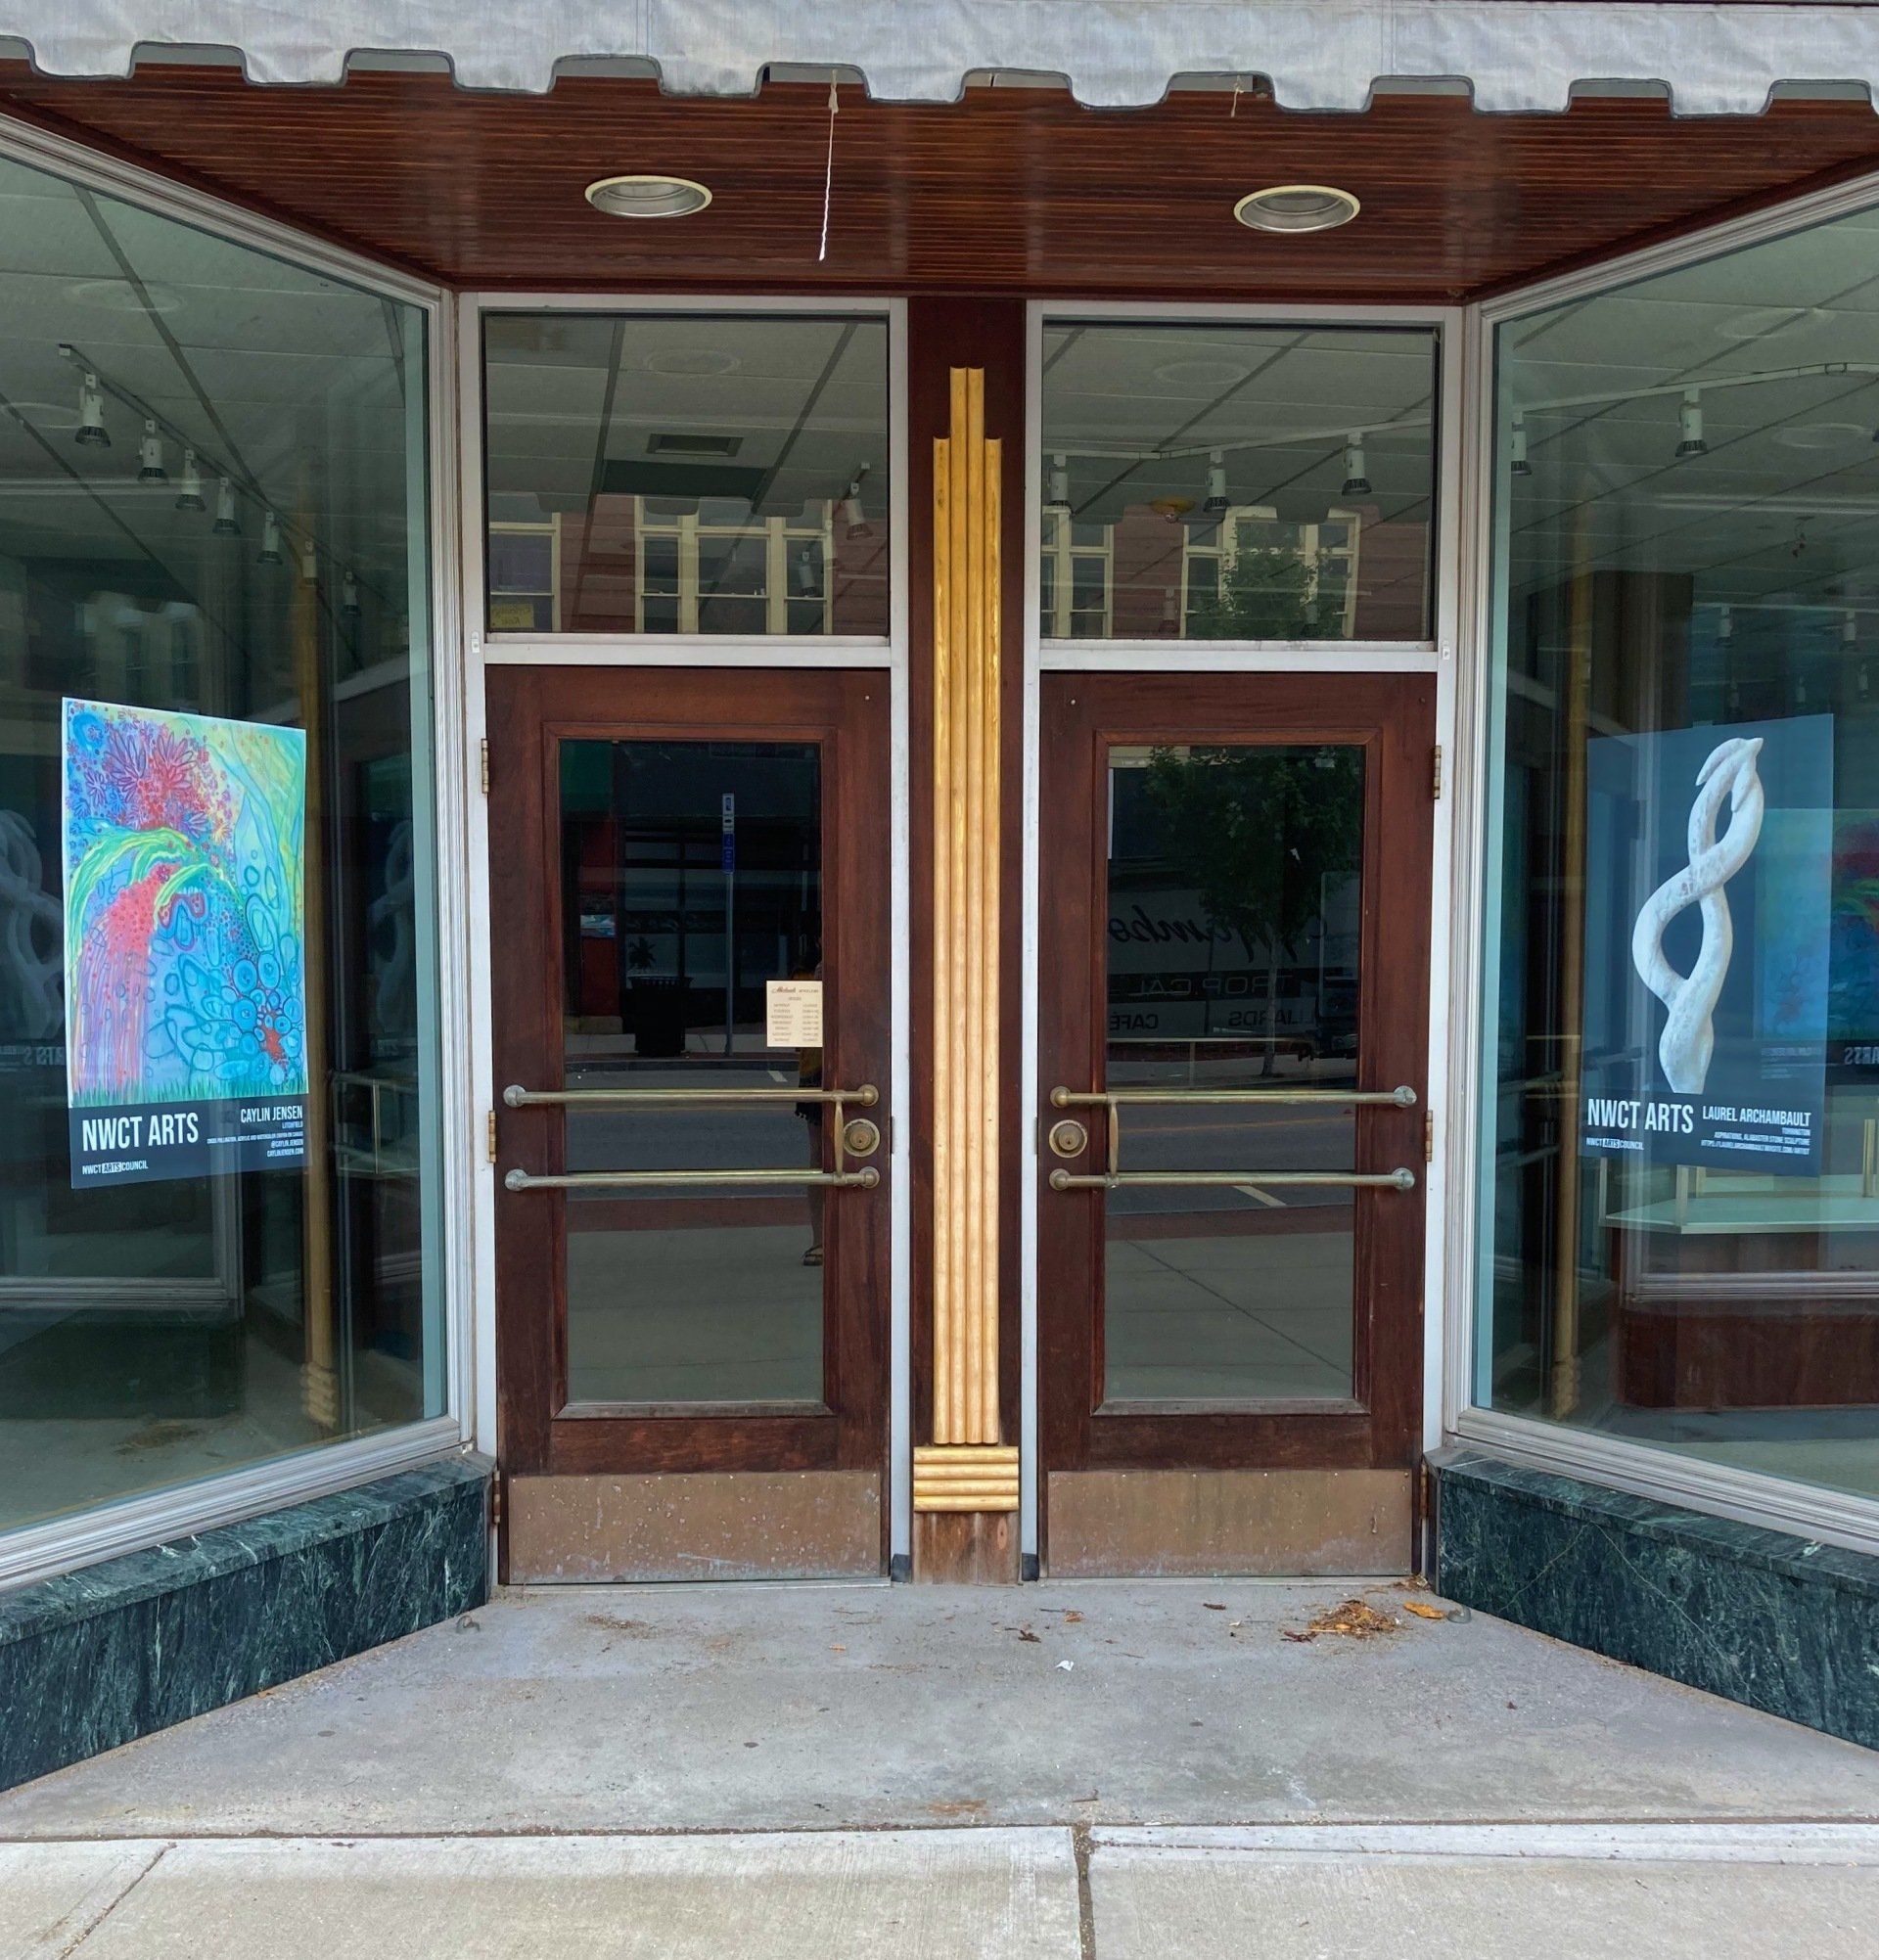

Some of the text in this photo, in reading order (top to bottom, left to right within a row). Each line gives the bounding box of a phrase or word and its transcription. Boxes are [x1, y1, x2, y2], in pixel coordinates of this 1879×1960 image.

[240, 1105, 303, 1123] CAYLIN JENSEN
[1587, 1098, 1694, 1134] NWCT ARTS
[1702, 1105, 1811, 1127] LAUREL ARCHAMBAULT
[81, 1112, 199, 1152] NWCT ARTS
